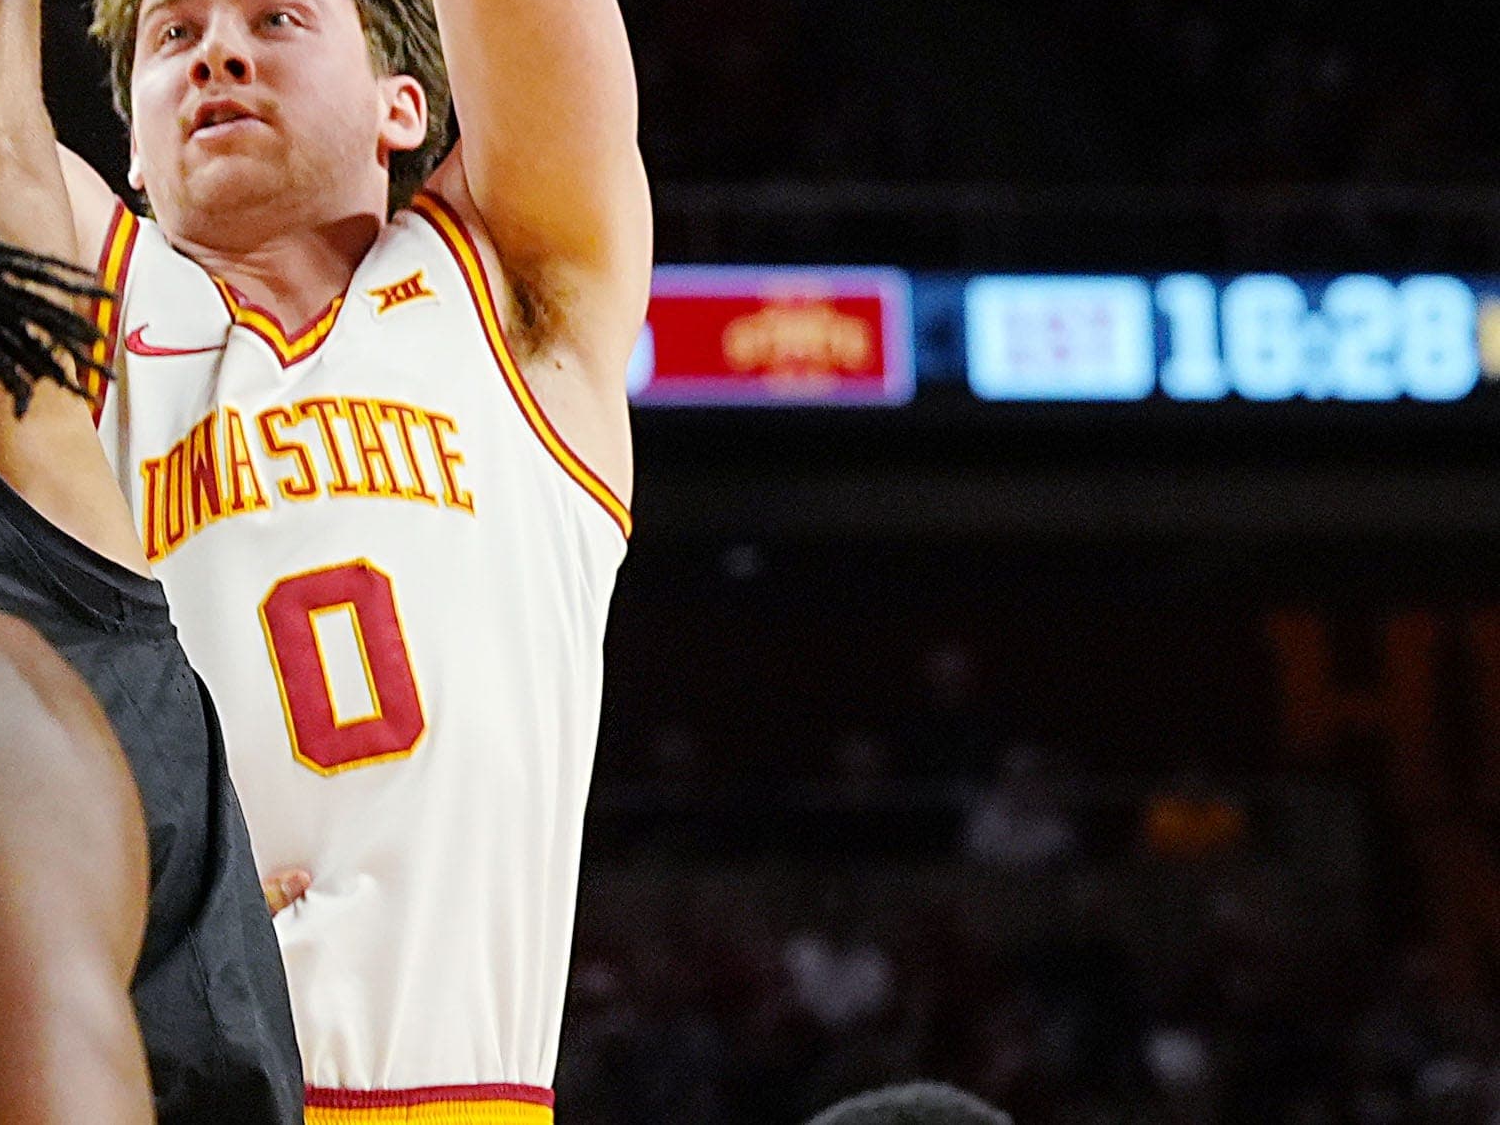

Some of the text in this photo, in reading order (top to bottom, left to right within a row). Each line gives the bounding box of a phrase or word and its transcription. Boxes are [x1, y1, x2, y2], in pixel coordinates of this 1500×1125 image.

[140, 396, 476, 563] IOWA STATE
[257, 558, 427, 777] 0
